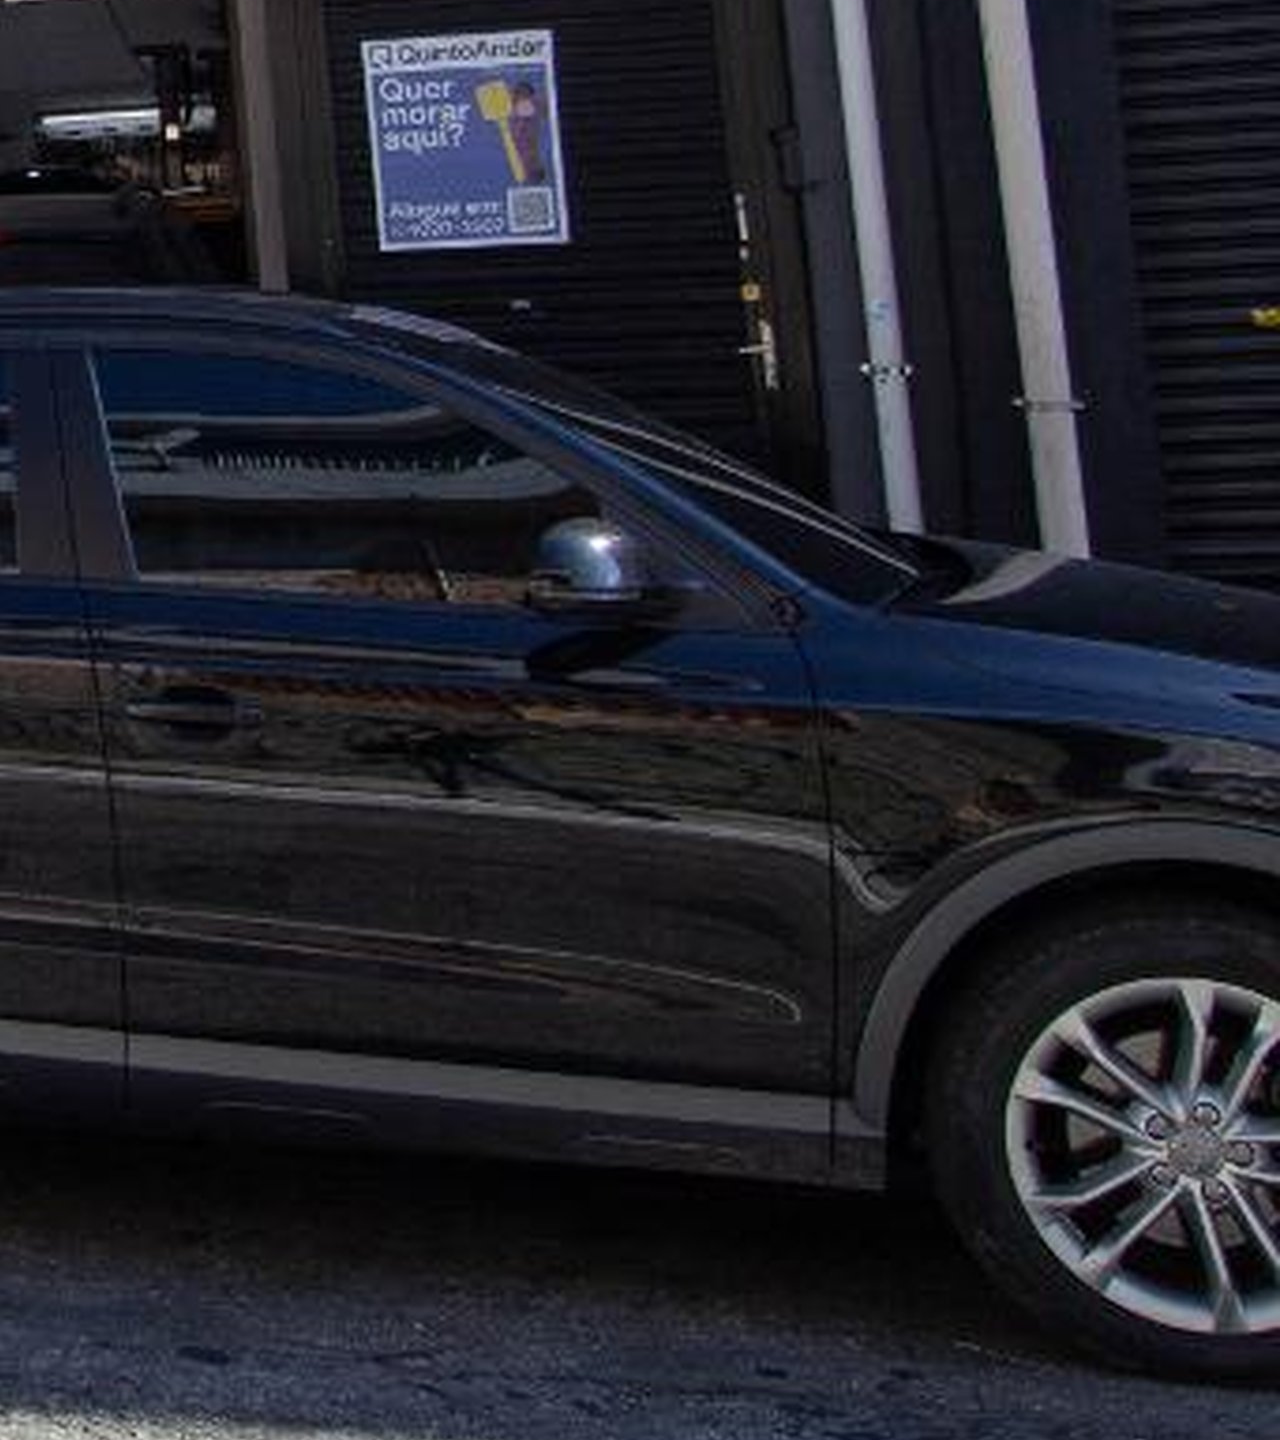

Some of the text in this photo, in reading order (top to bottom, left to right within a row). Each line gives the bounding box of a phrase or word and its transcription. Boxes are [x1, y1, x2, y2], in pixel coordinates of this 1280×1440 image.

[379, 78, 453, 102] Quer
[382, 102, 471, 125] morar
[383, 123, 464, 153] aqui?
